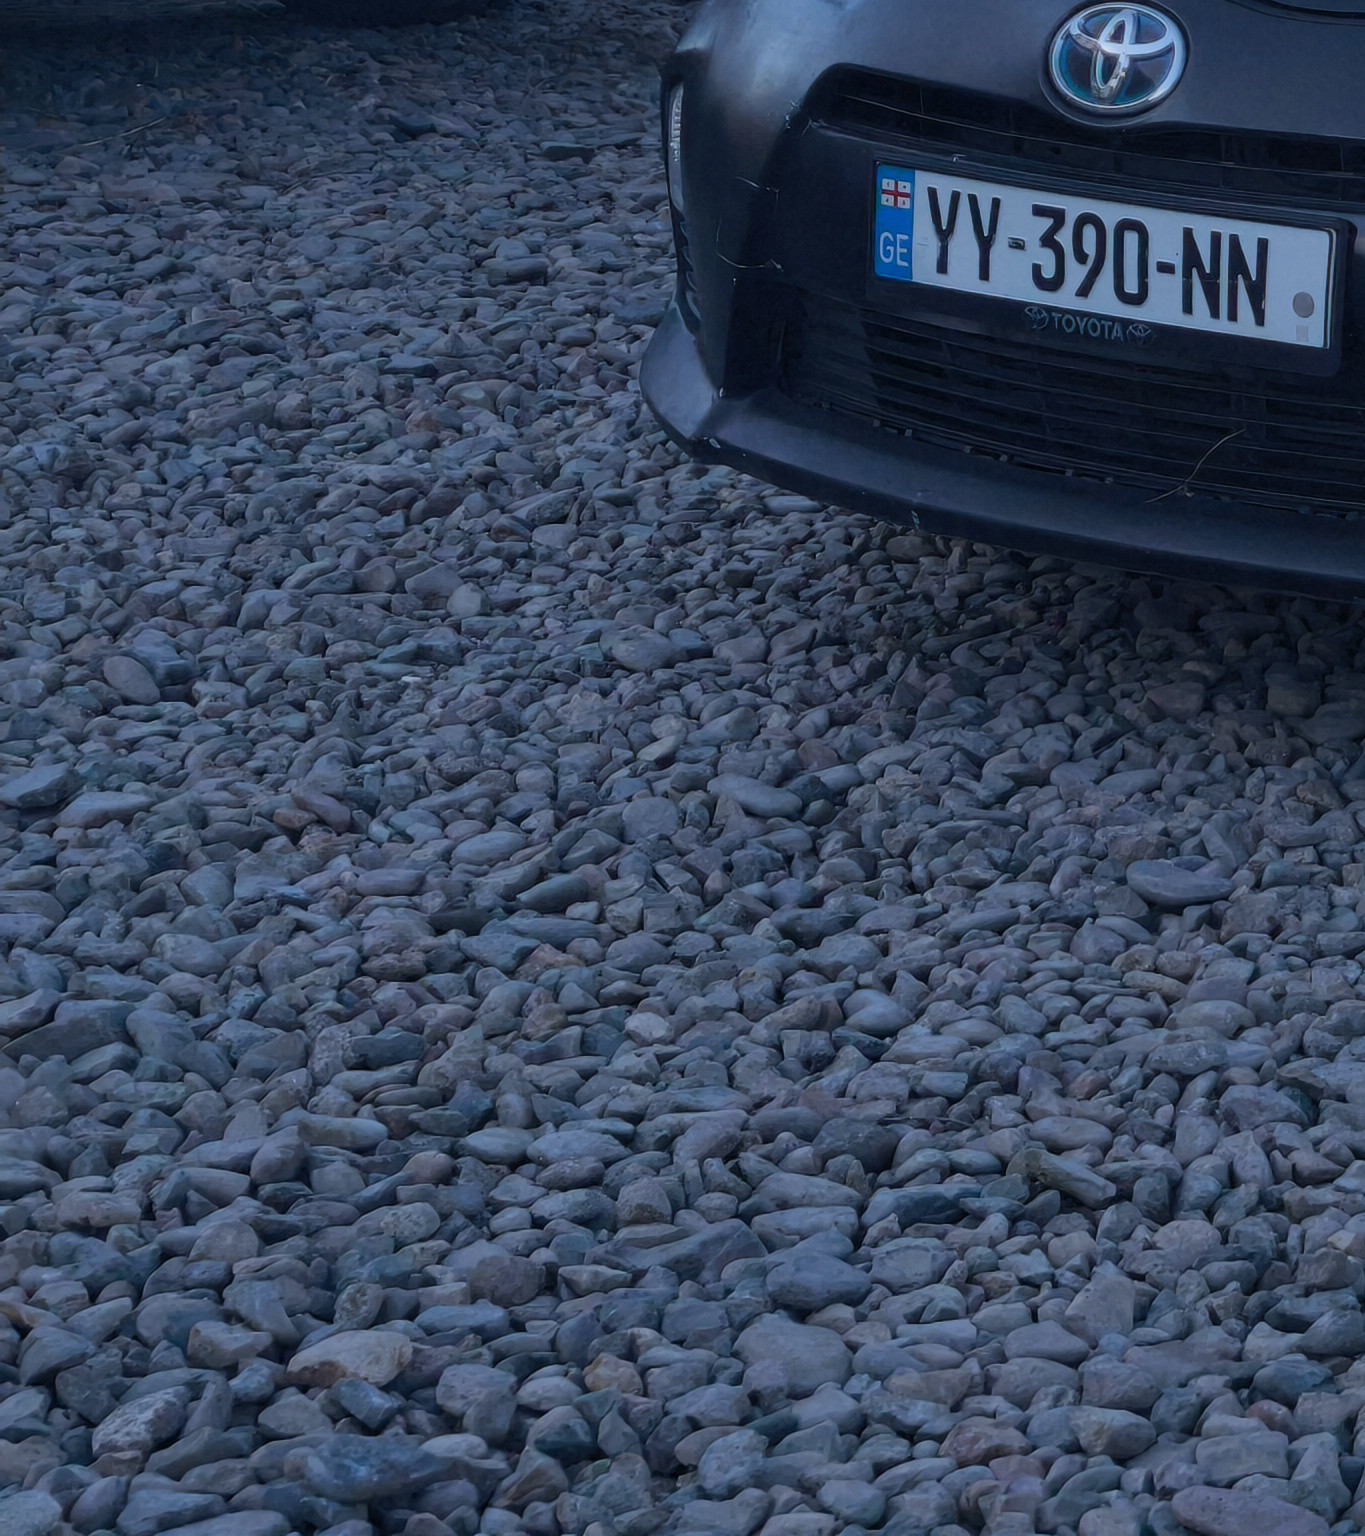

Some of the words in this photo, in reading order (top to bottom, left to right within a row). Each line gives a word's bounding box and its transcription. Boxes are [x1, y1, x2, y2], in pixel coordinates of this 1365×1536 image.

[878, 231, 910, 267] GE
[926, 185, 1269, 327] YY-390-NN
[1050, 311, 1125, 342] TOYOTA
